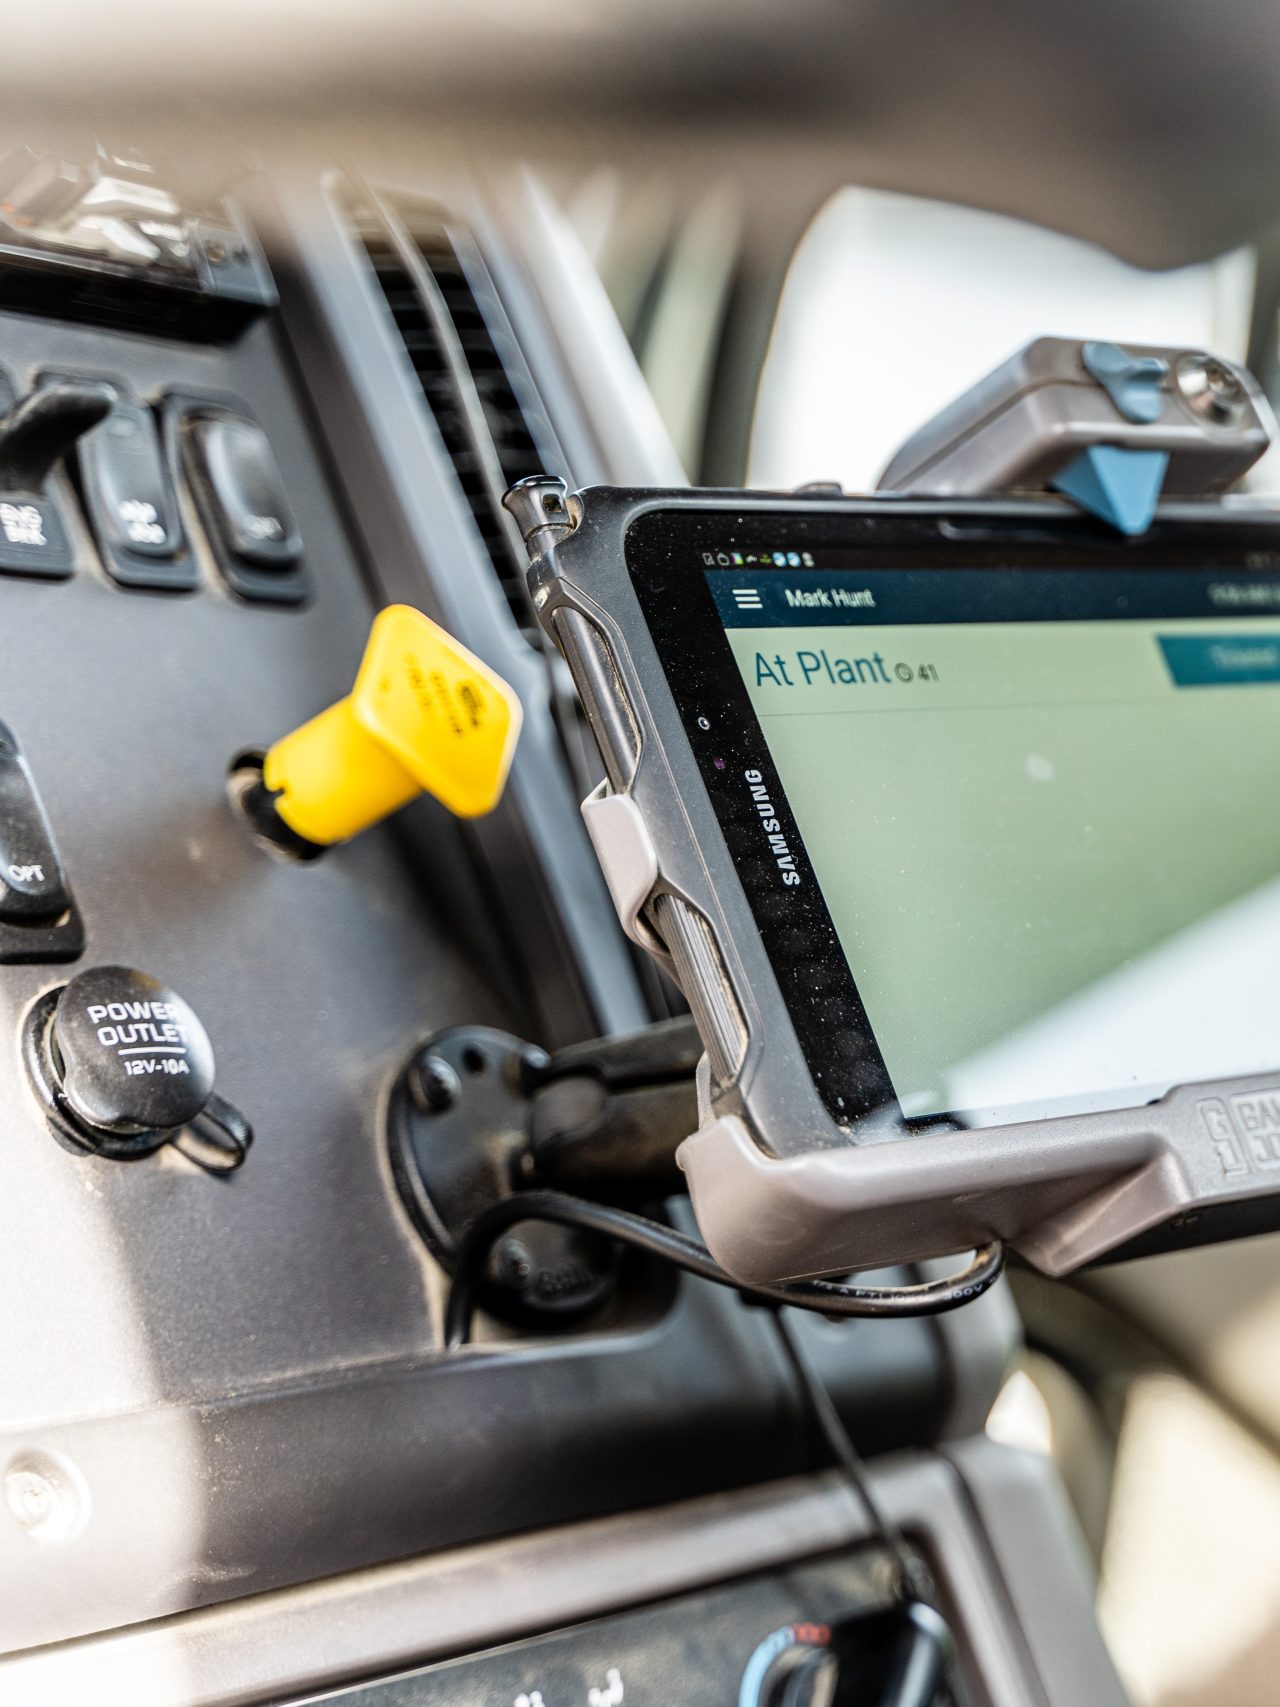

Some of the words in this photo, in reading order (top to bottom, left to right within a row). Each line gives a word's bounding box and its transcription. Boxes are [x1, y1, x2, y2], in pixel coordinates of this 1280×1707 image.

[784, 588, 832, 608] Mark
[830, 588, 877, 608] Hunt
[755, 652, 794, 687] At
[796, 649, 892, 685] Plant
[744, 769, 800, 886] SAMSUNG
[87, 1001, 181, 1024] POWER
[97, 1022, 191, 1046] OUTLET
[124, 1058, 190, 1076] 12V-10A
[944, 1283, 984, 1301] 00V
